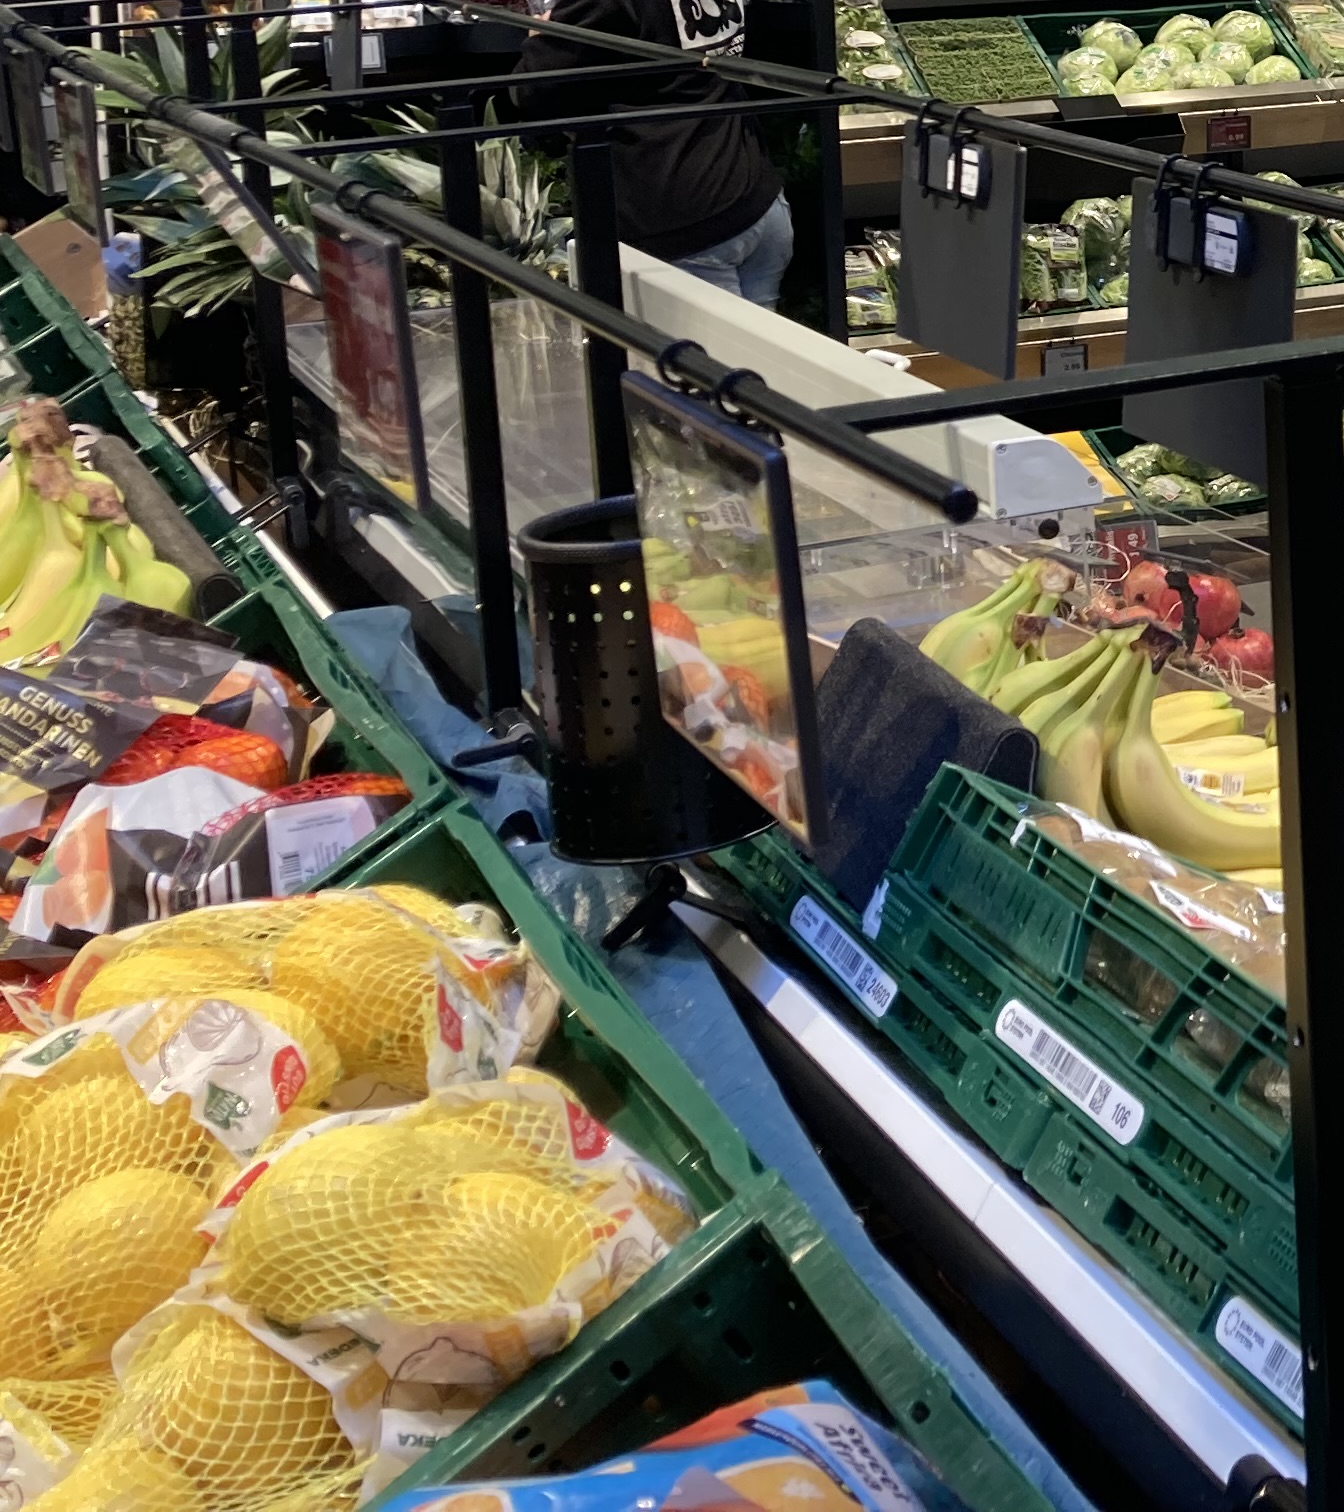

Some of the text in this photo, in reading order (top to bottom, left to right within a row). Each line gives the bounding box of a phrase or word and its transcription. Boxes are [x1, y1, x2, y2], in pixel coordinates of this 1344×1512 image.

[1127, 533, 1140, 558] 149
[19, 685, 94, 735] GENUSS
[1111, 1102, 1132, 1130] 106
[397, 1431, 440, 1448] EKA
